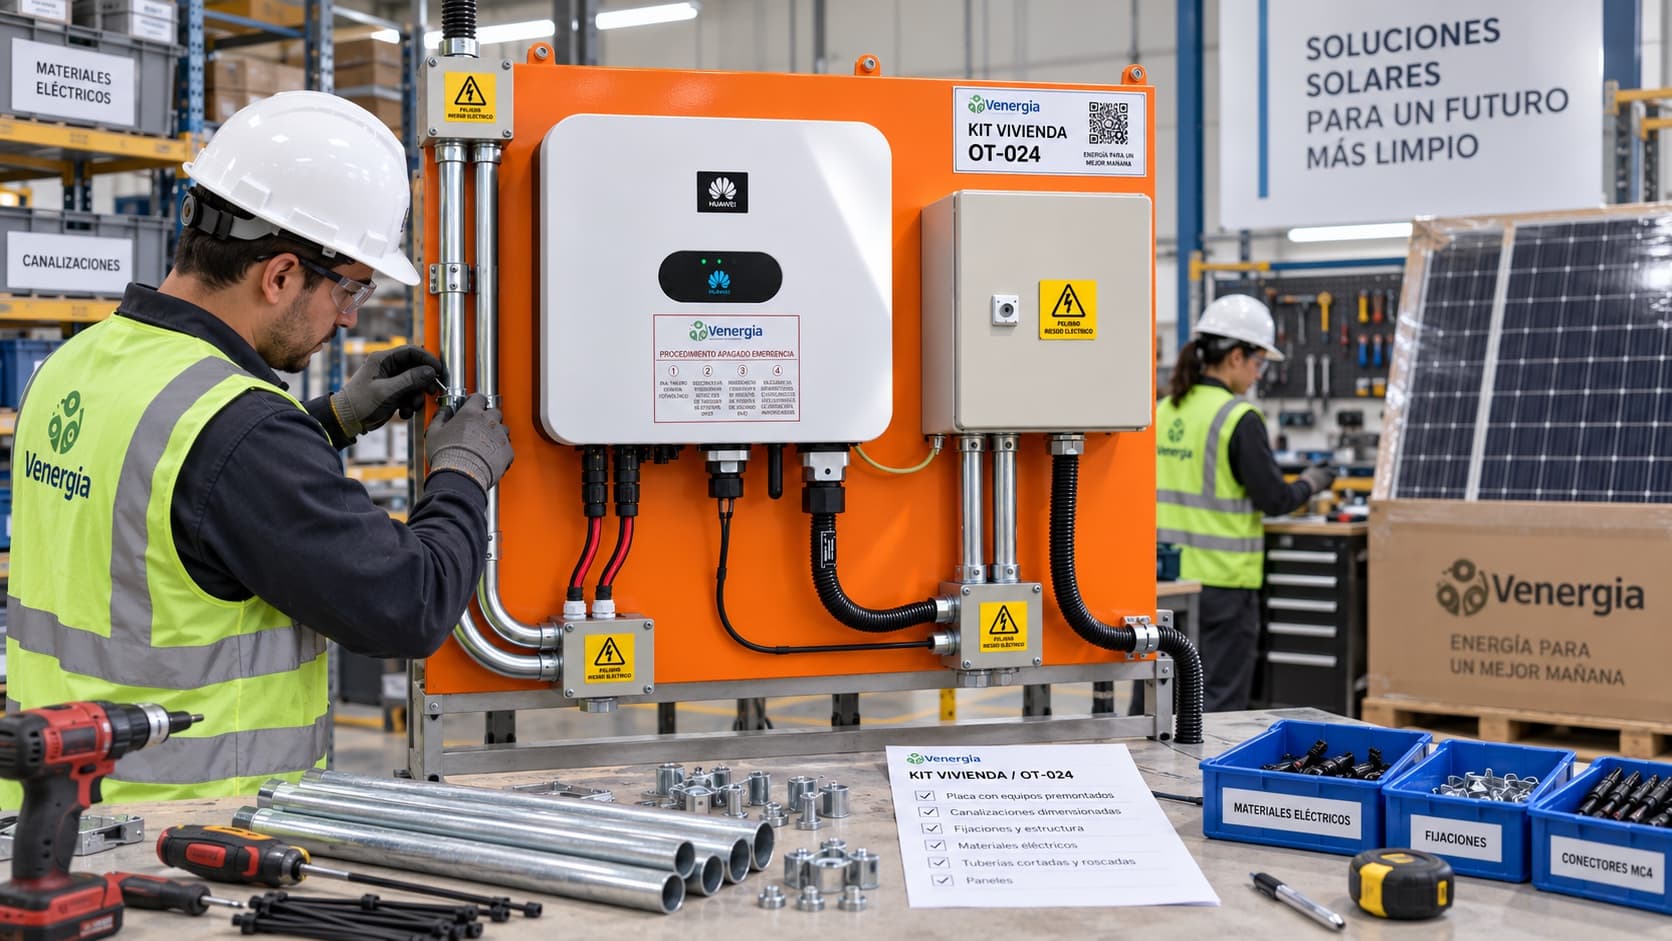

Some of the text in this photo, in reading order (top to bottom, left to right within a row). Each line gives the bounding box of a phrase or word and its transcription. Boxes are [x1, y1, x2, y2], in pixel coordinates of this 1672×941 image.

[1306, 17, 1501, 61] SOLUCIONES
[36, 61, 112, 85] MATERIALES
[1306, 61, 1441, 98] SOLARES
[36, 81, 112, 105] ELÉCTRICOS
[986, 100, 1041, 114] Venergia
[1307, 88, 1570, 134] PARA UN FUTURO
[968, 123, 1068, 139] KIT VIVIENDA
[968, 144, 1041, 163] OT-024
[1307, 133, 1479, 171] MÁS LIMPIO
[22, 254, 121, 272] CANALIZACIONES
[708, 324, 763, 339] Venergia
[717, 350, 751, 358] APAGADO
[25, 450, 92, 501] Venergia
[1491, 573, 1645, 617] Venergia
[1450, 633, 1591, 659] ENERGÍA PARA
[1450, 659, 1626, 687] UN MEJOR MAÑANA
[924, 755, 981, 764] Venergia
[909, 771, 933, 780] KIT
[938, 770, 1008, 780] VIVIENDA
[1020, 770, 1074, 780] OT-024
[946, 791, 976, 800] Placa
[1001, 792, 1043, 801] equipos
[1045, 791, 1115, 801] premontados
[950, 807, 1123, 816] Canalizaciones dimensionadas
[1234, 802, 1351, 826] MATERIALES ELÉCTRICOS
[954, 824, 1013, 834] Fijaciones
[1024, 824, 1085, 833] estructura
[958, 841, 1019, 850] Materiales
[1425, 830, 1487, 849] FIJACIONES
[1017, 858, 1070, 866] cortadas
[1073, 860, 1079, 868] y
[1081, 857, 1137, 866] roscadas
[1562, 852, 1654, 879] CONECTORES MC4
[966, 876, 1014, 885] Paneles
